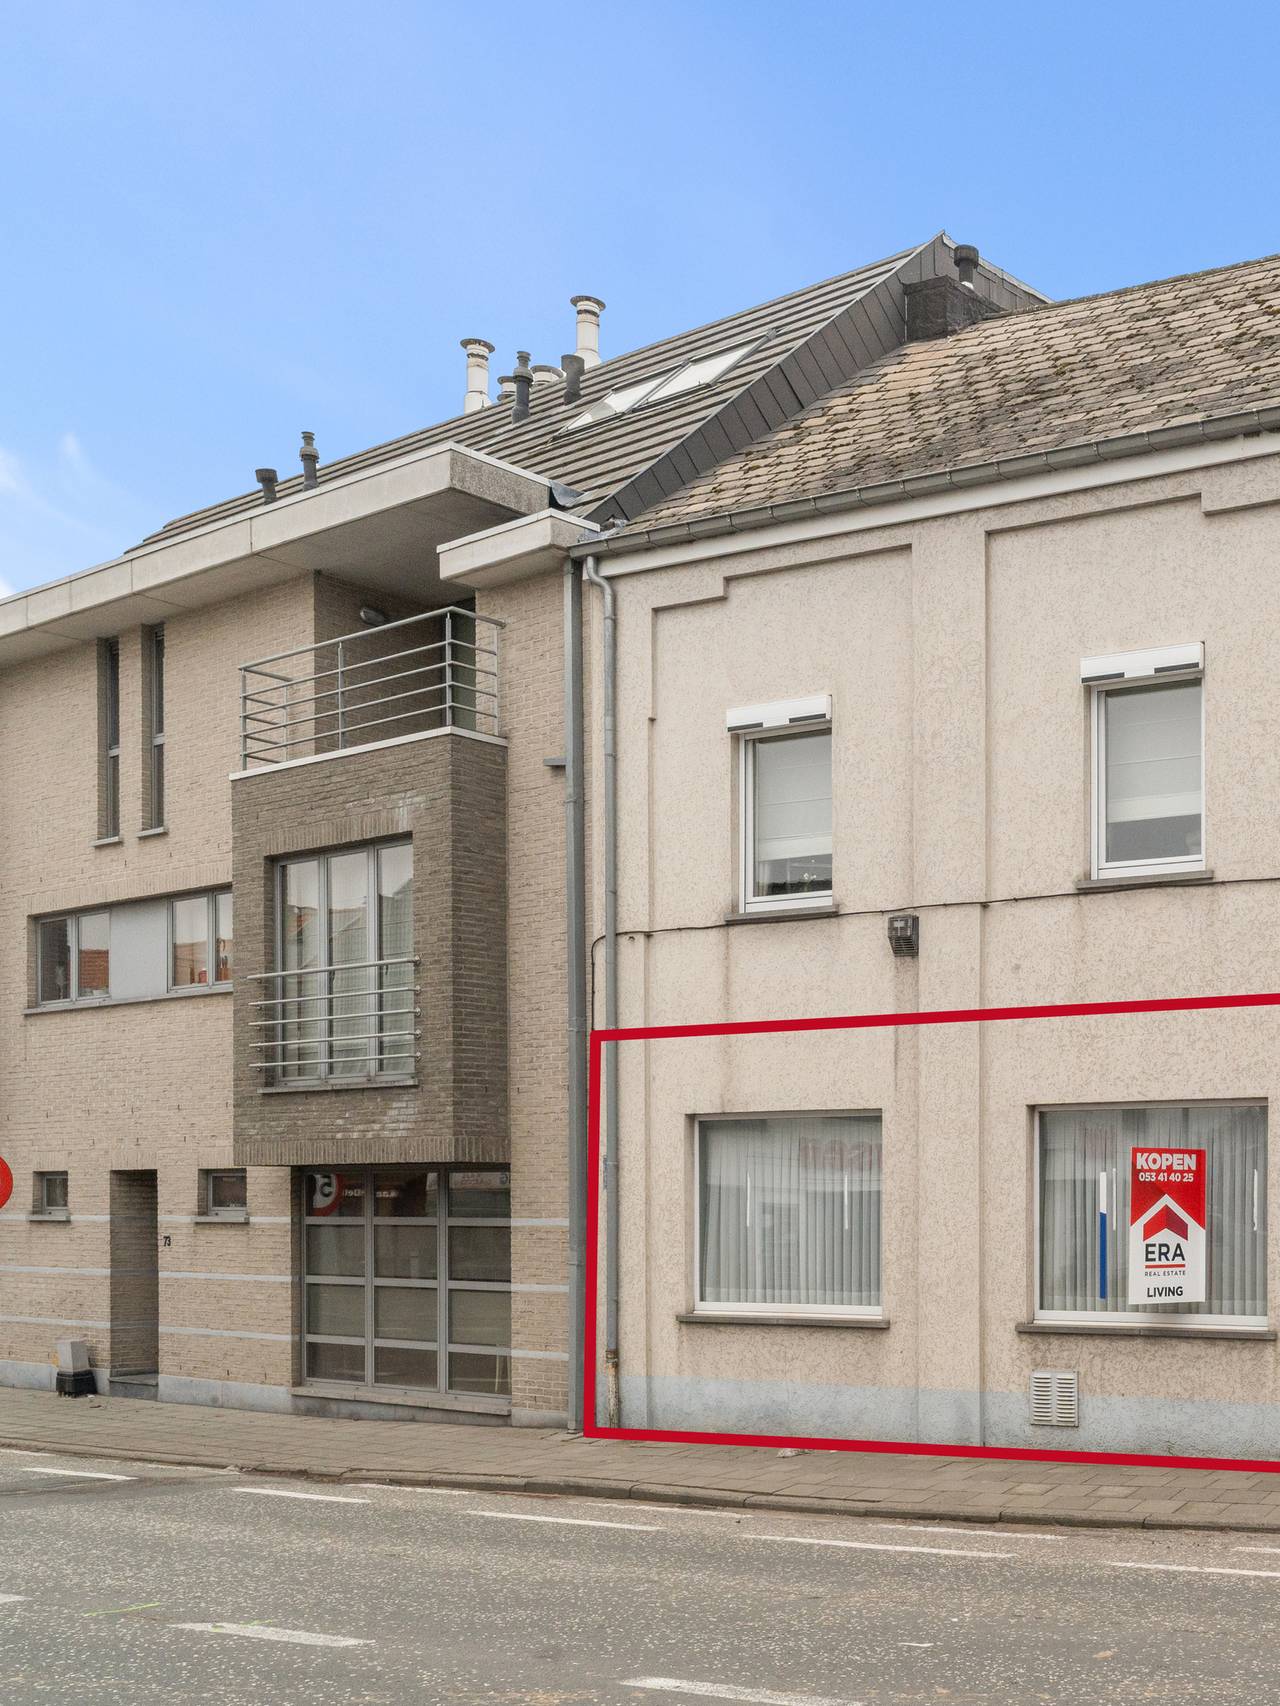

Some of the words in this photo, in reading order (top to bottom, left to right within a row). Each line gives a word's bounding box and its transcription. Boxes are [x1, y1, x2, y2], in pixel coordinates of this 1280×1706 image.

[1136, 1152, 1197, 1171] KOPEN
[1138, 1172, 1157, 1182] 053
[1157, 1172, 1168, 1182] 41
[1169, 1172, 1181, 1182] 40
[1182, 1173, 1194, 1183] 25
[163, 1235, 171, 1247] 73
[1145, 1243, 1186, 1262] ERA
[1146, 1286, 1183, 1298] LIVING
